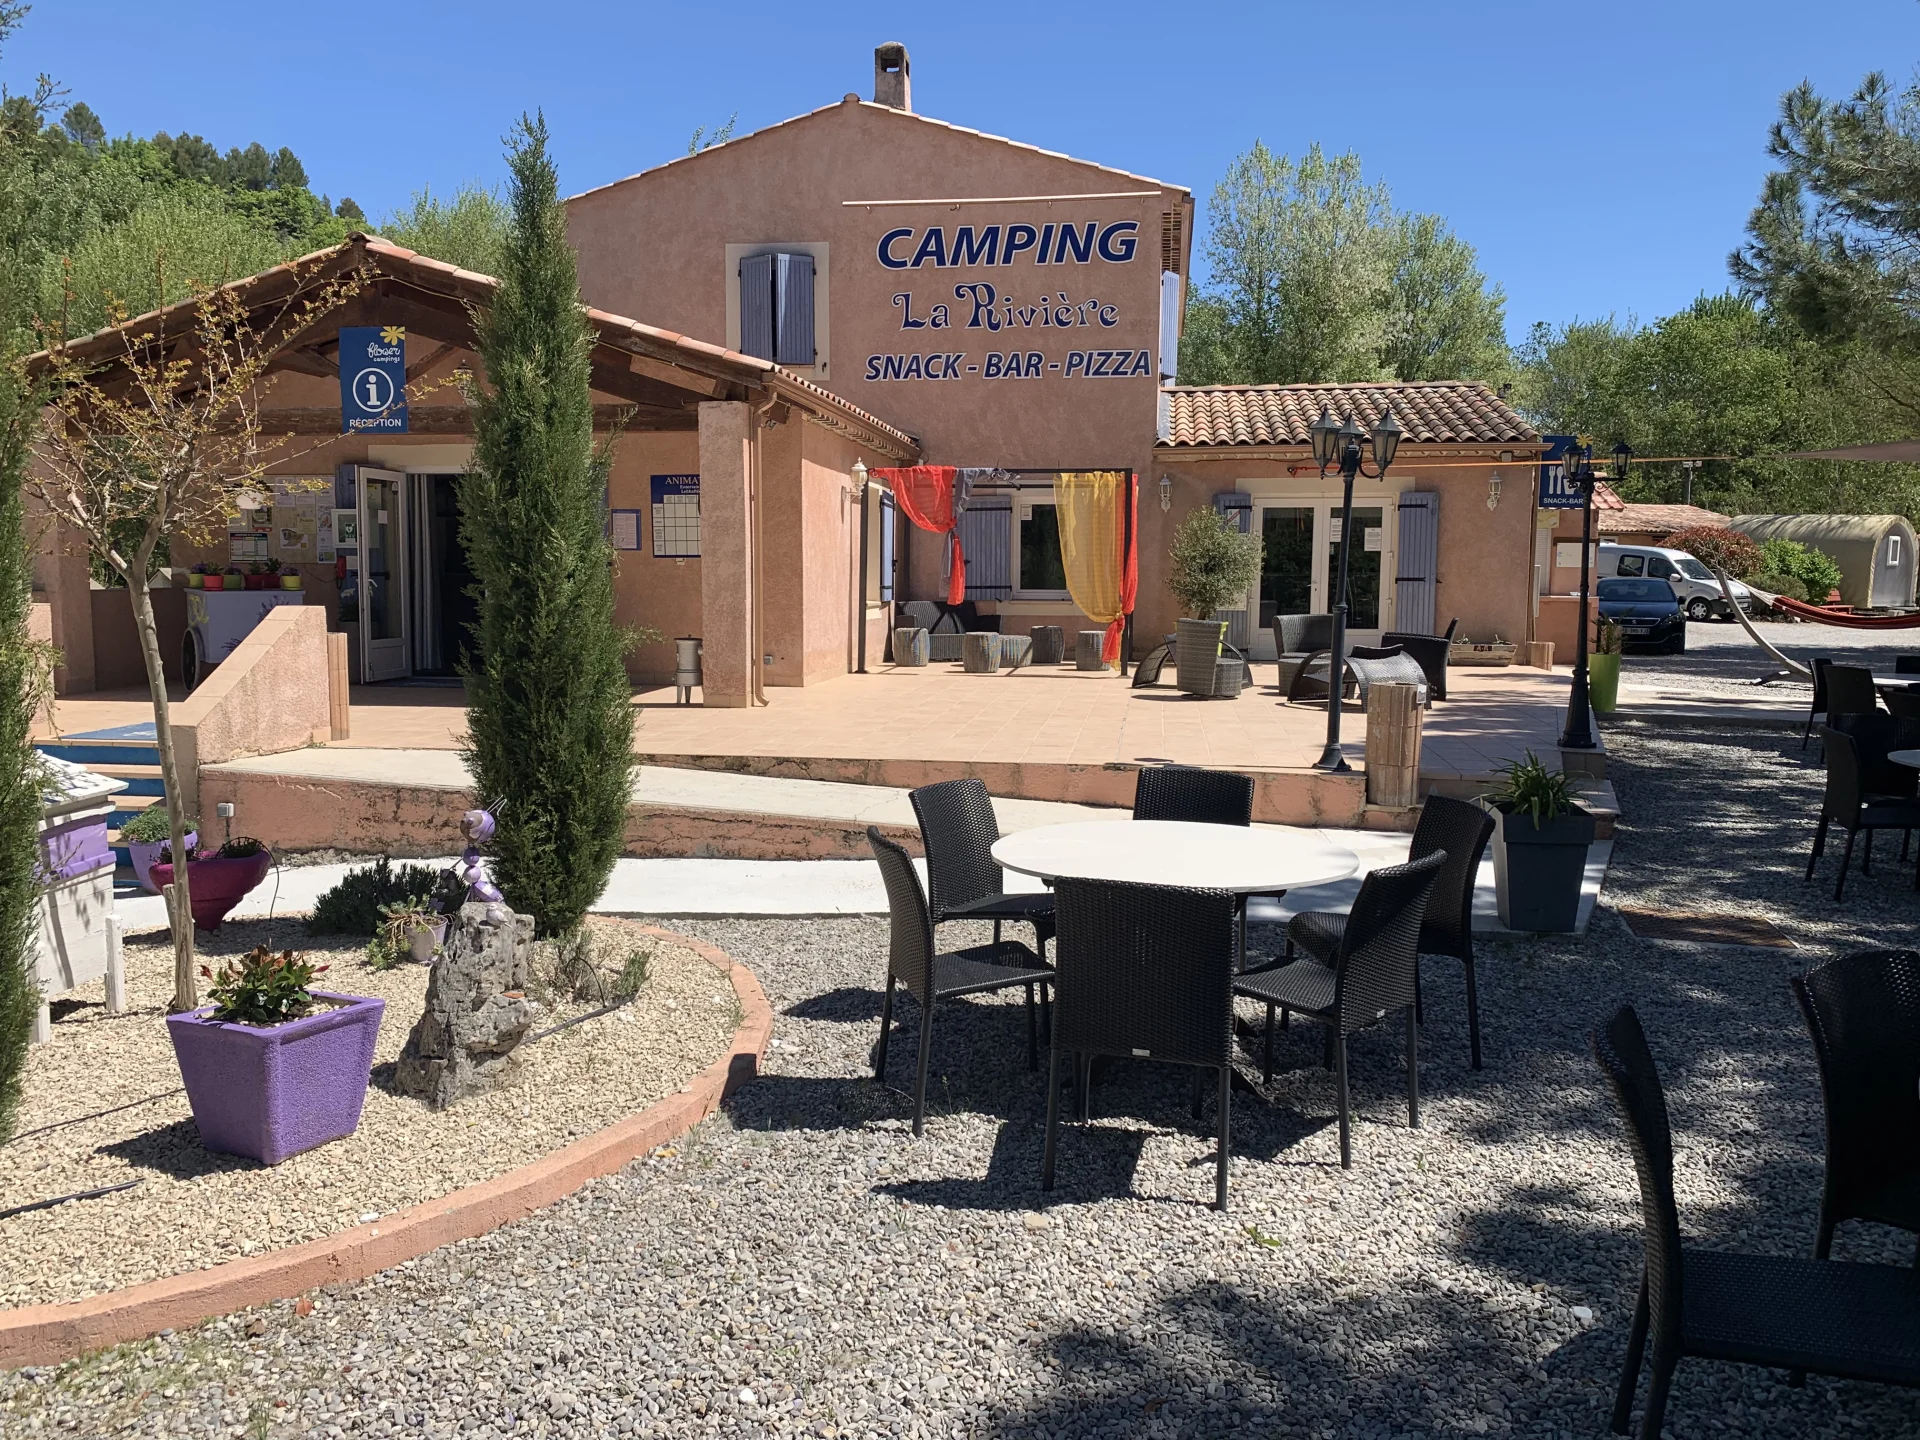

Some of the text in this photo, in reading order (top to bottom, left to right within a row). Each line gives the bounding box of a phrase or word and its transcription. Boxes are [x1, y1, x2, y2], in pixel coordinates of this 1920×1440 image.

[876, 221, 1141, 270] CAMPING
[892, 281, 1120, 333] La Rivière
[865, 352, 965, 381] SNACK
[982, 351, 1045, 380] BAR
[1063, 349, 1152, 378] PIZZA
[1543, 497, 1584, 505] SNACK-BAR
